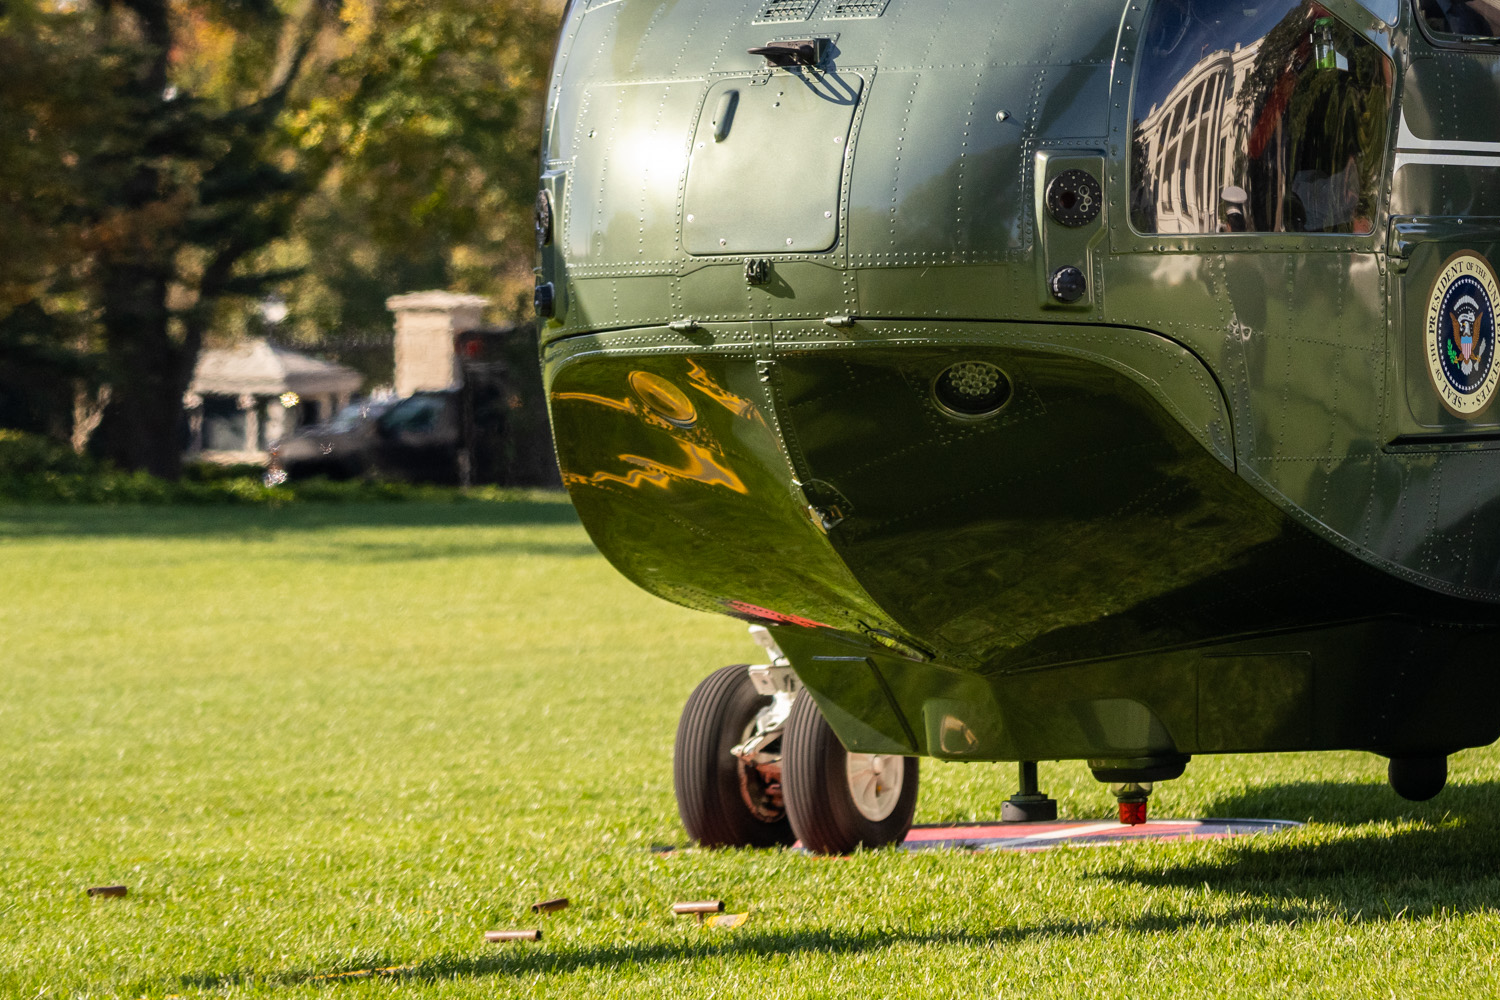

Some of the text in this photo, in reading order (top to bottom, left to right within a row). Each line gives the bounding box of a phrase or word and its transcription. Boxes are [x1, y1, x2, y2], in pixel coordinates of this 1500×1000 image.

[1466, 261, 1474, 271] OF
[1475, 264, 1487, 281] THE
[1428, 261, 1464, 334] PRESIDENT
[1429, 339, 1437, 366] THE
[1435, 368, 1443, 381] OF
[1476, 362, 1500, 407] STATES
[1442, 381, 1463, 409] SEAL
